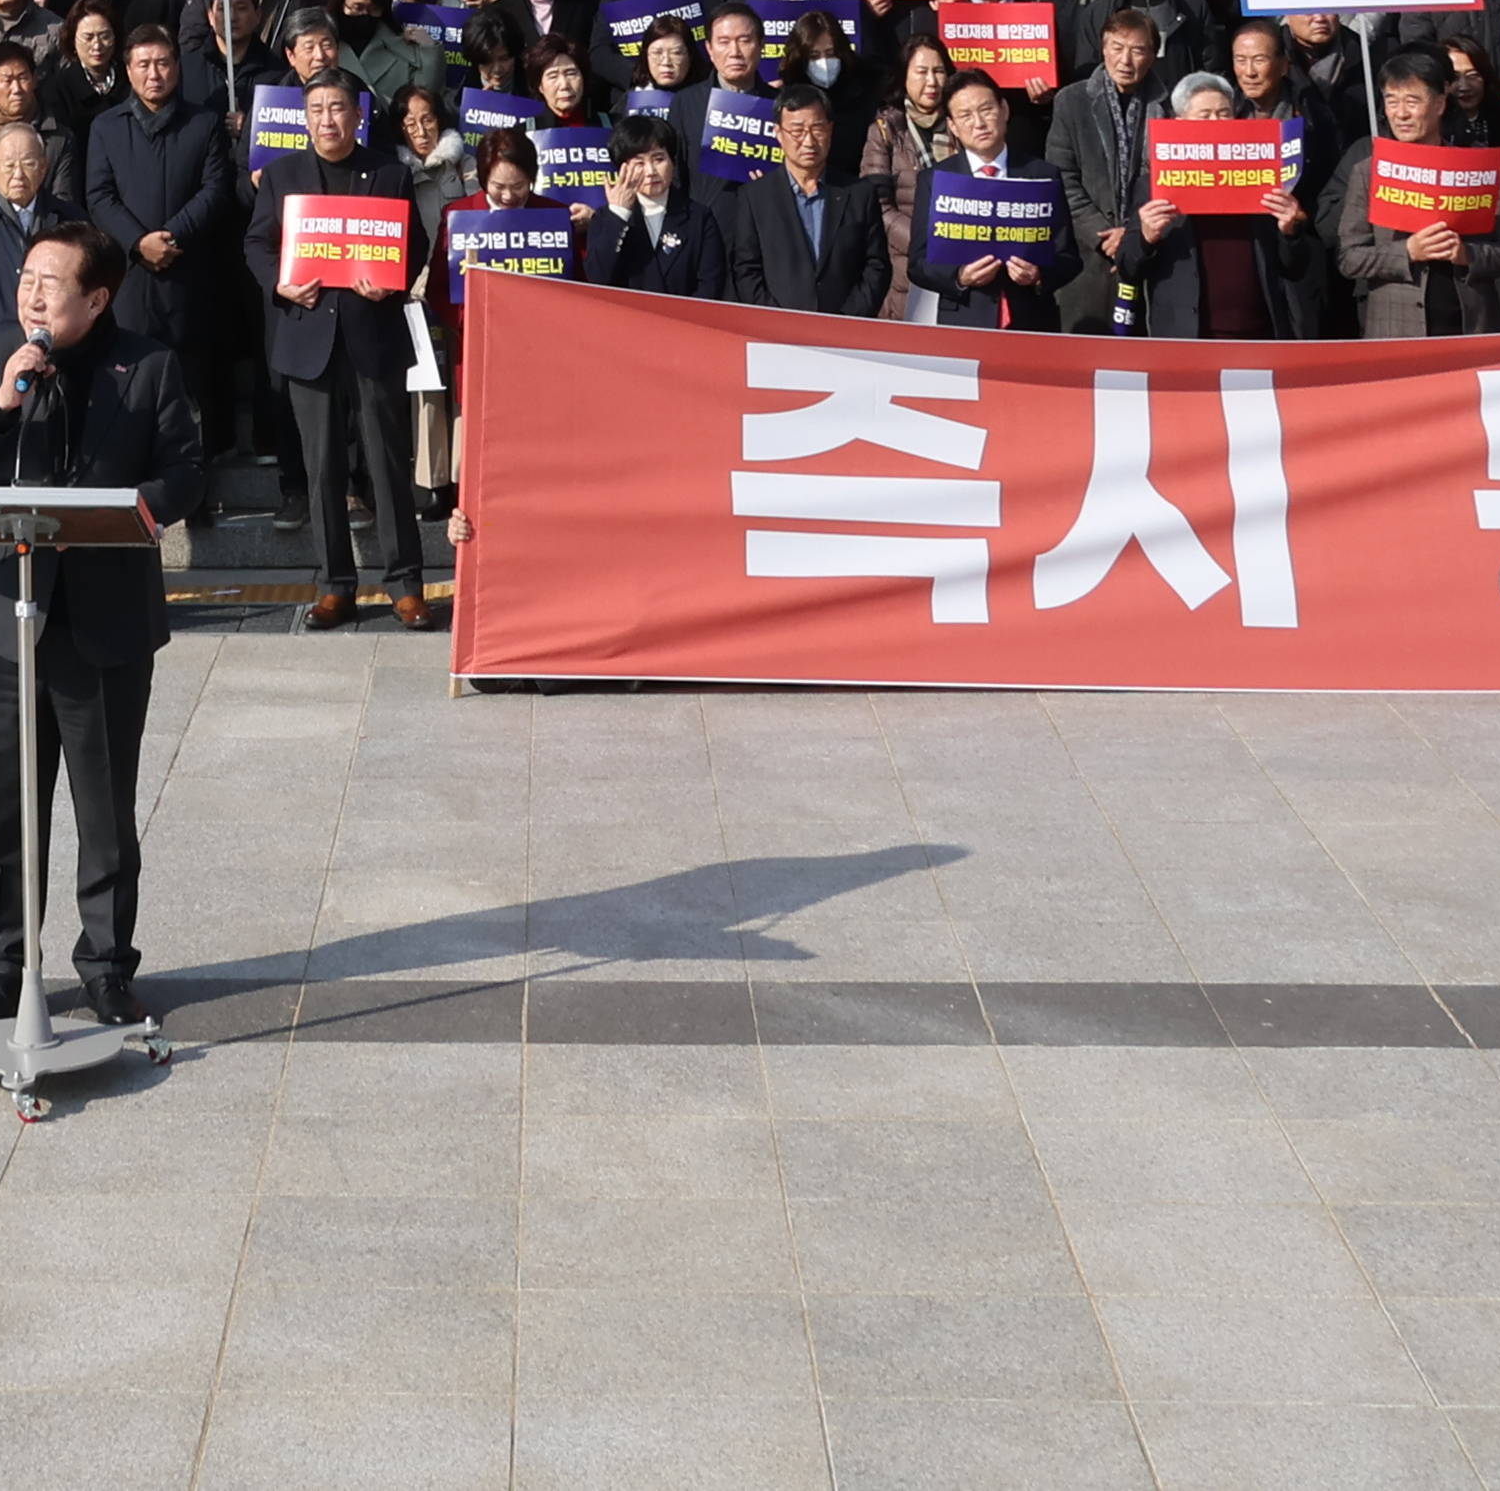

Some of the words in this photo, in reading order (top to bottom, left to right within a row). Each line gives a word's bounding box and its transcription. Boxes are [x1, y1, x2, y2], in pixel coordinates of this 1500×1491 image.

[1156, 143, 1214, 160] 중대재해
[1217, 143, 1275, 160] 불안감에
[1157, 170, 1214, 186] 사라지는
[1219, 169, 1275, 186] 기업의욕
[1377, 160, 1437, 185] 중대재해
[1440, 170, 1496, 186] 불안감에
[935, 195, 993, 216] 산재예방
[996, 202, 1052, 218] 동참한다
[1376, 186, 1434, 210] 사라지는
[1438, 195, 1492, 211] 기업의욕
[346, 219, 401, 238] 불안감에
[934, 221, 992, 241] 처벌불안
[995, 226, 1050, 242] 없애달라
[346, 244, 400, 262] 기업의욕
[730, 341, 1298, 628] 즉시
